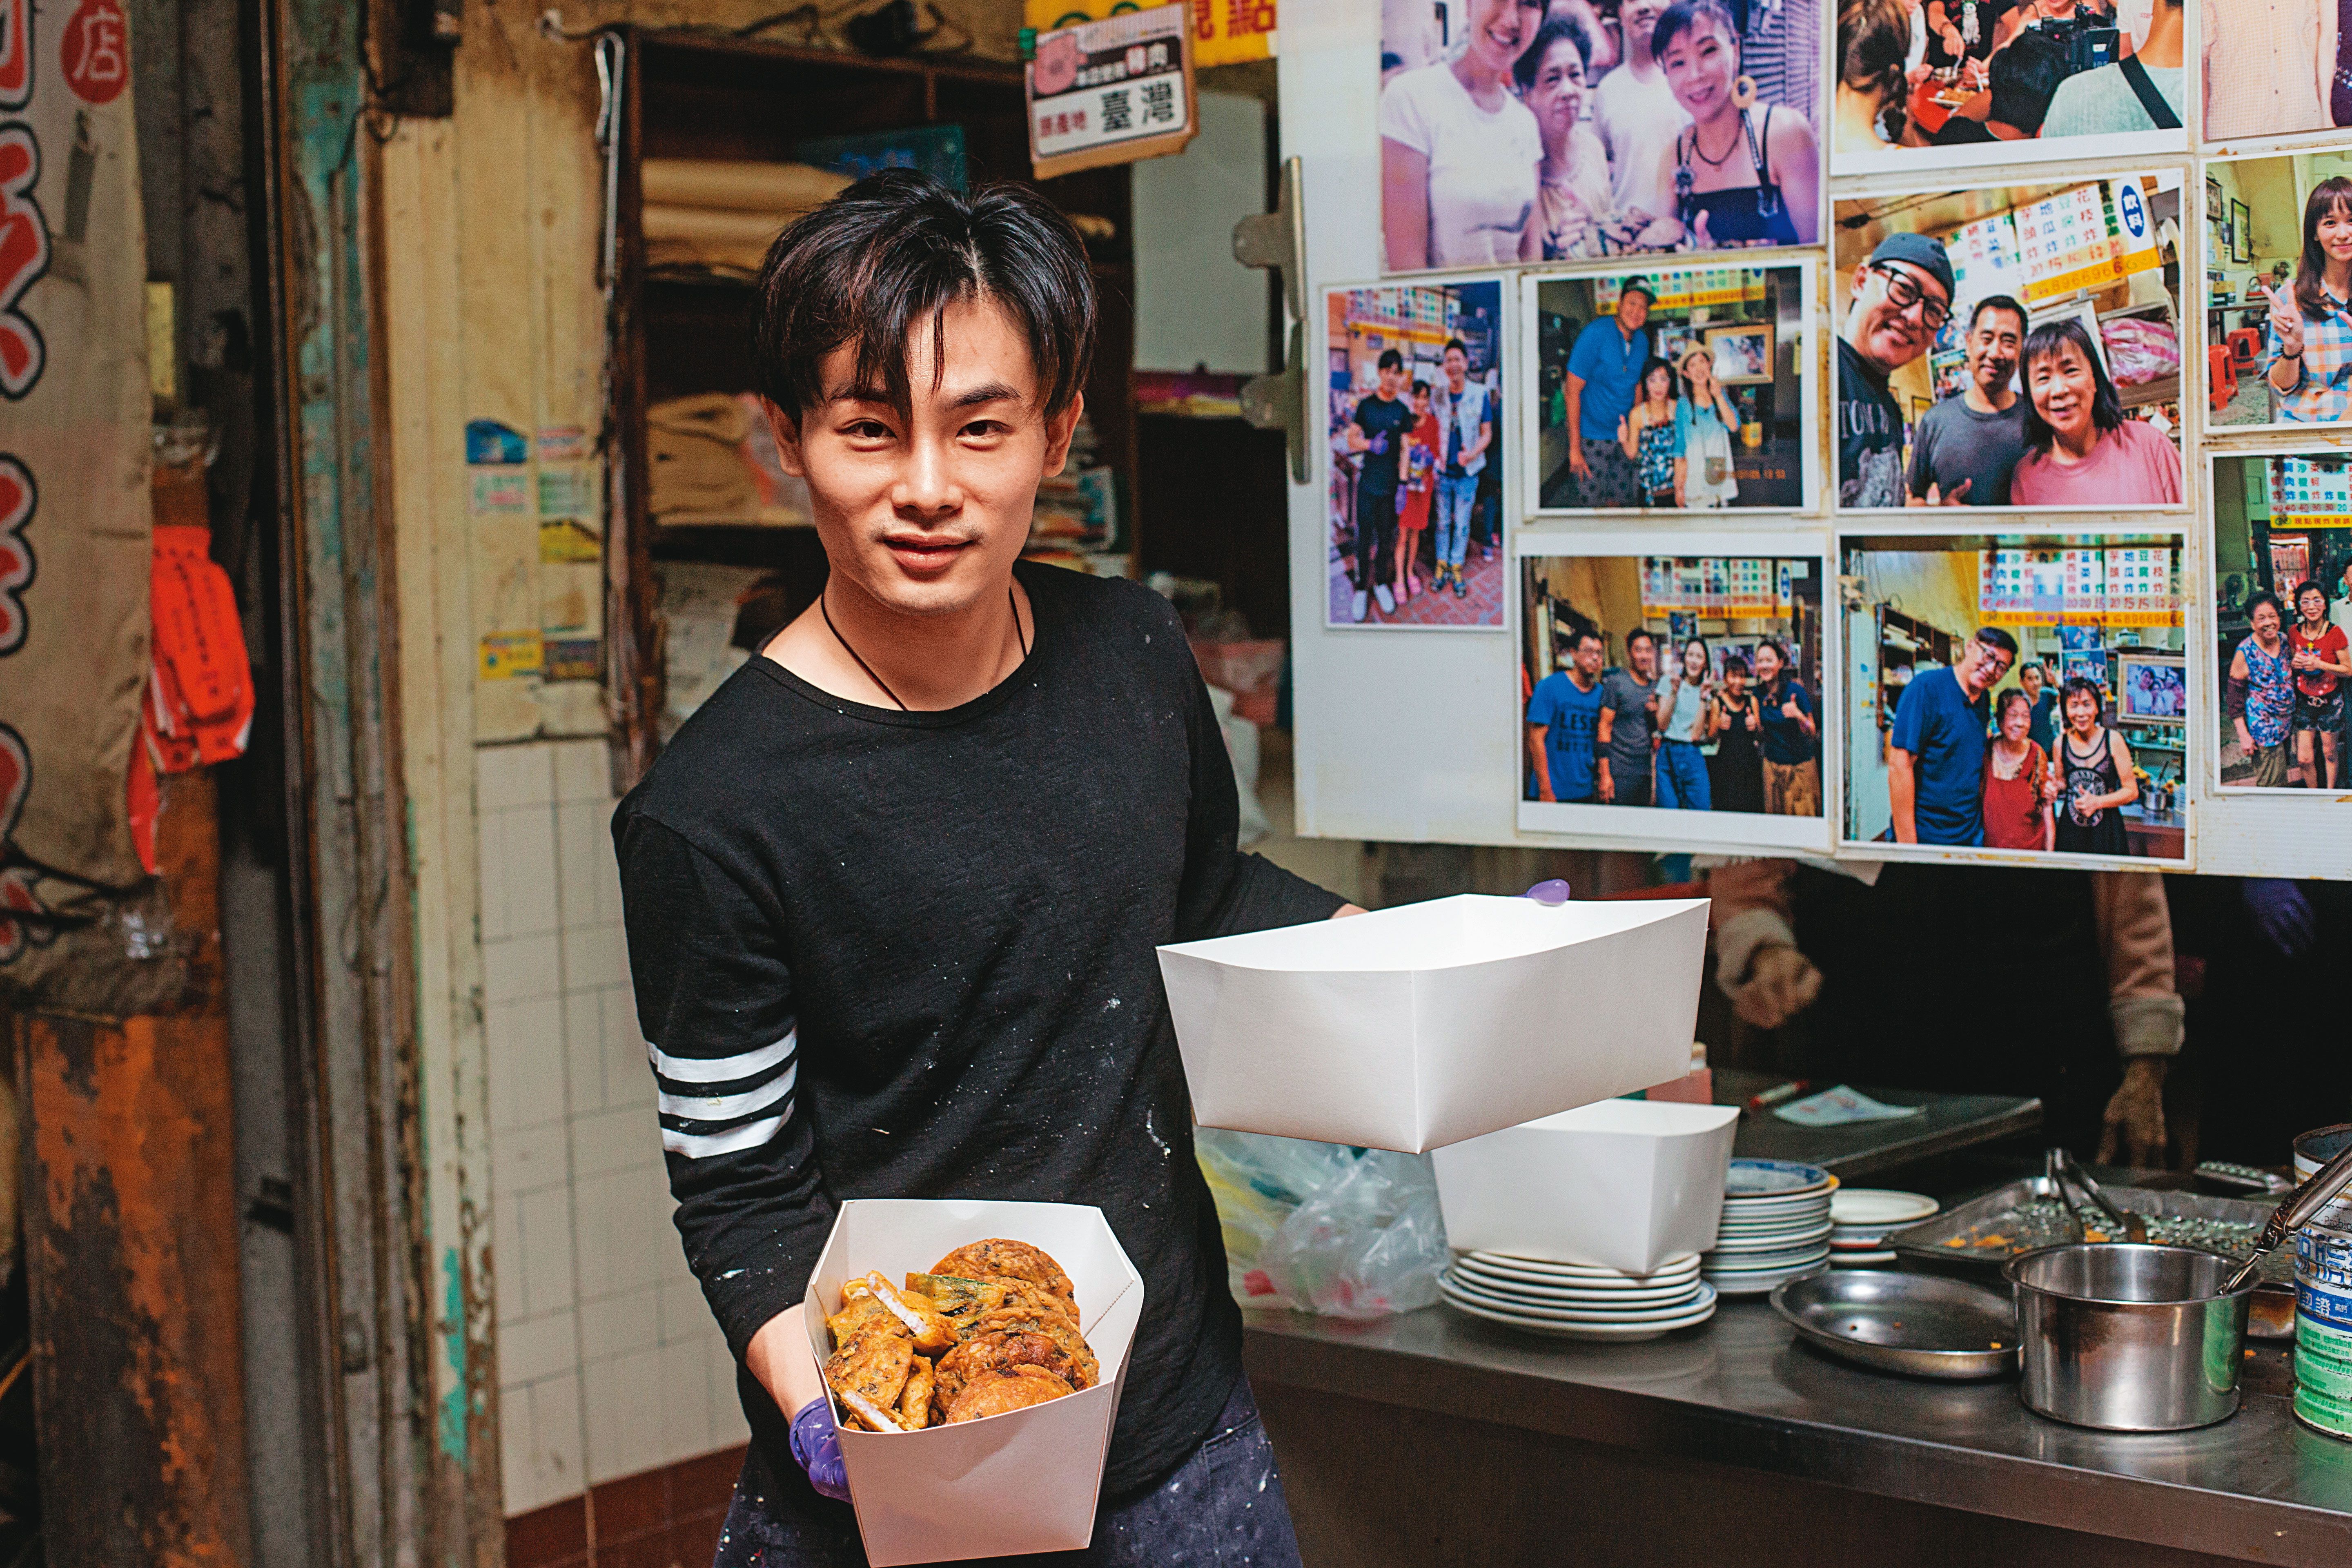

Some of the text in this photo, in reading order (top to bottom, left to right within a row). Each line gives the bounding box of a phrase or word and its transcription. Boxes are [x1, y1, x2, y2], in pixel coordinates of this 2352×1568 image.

[73, 7, 122, 80] 店
[1102, 81, 1174, 133] 臺灣
[2337, 503, 2347, 512] 20
